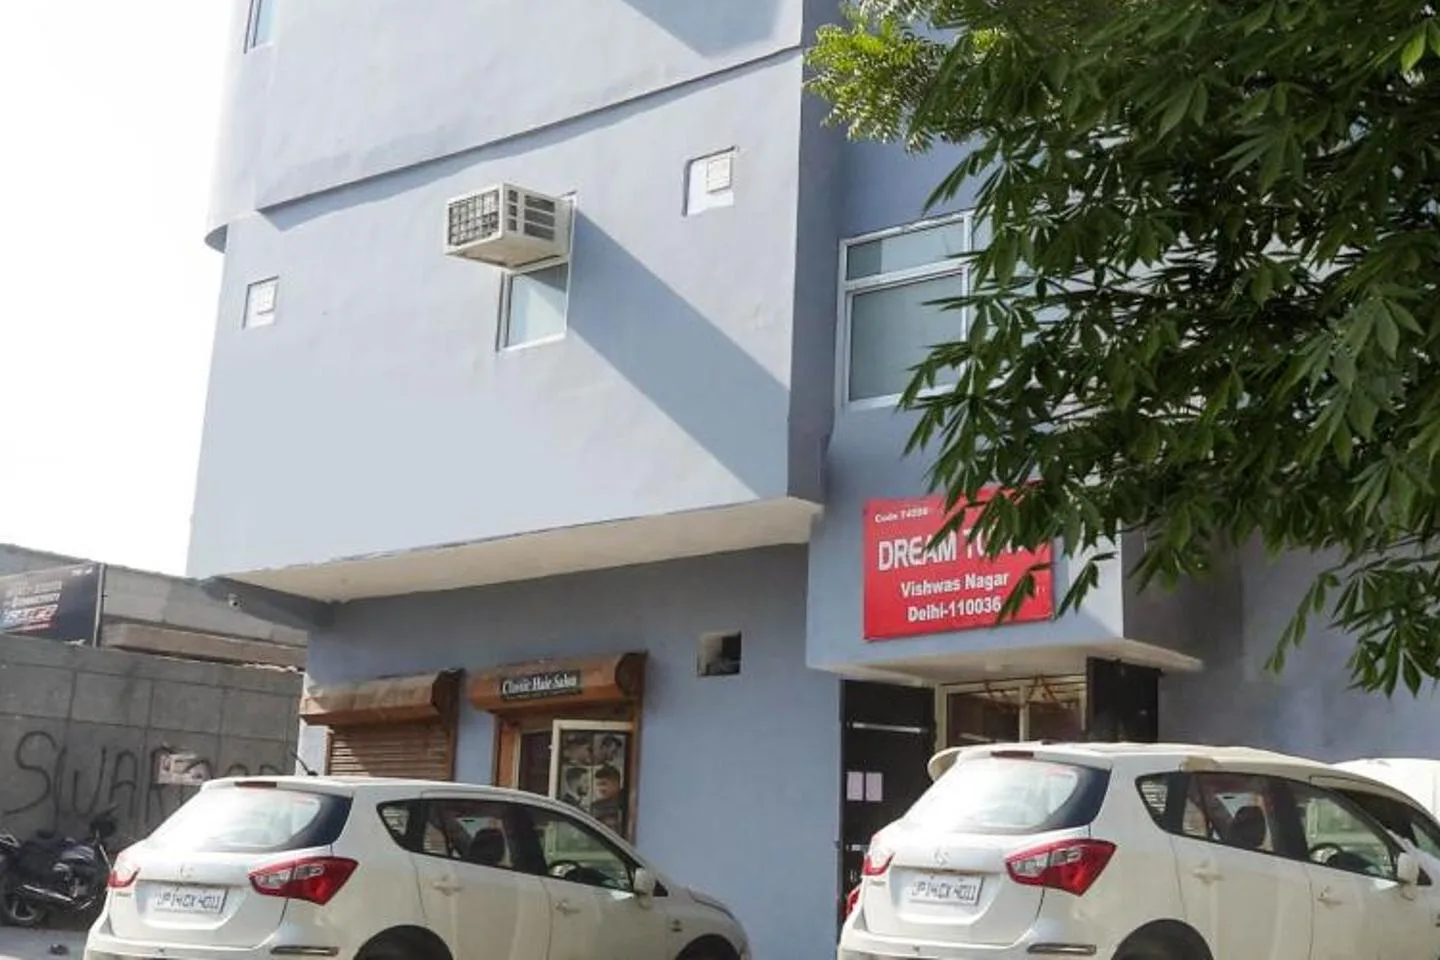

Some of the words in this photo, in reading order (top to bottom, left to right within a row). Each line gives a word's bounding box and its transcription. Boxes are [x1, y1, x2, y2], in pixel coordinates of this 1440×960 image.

[877, 530, 957, 571] DREAM
[901, 579, 961, 597] Vishwas
[964, 573, 1009, 591] Nagar
